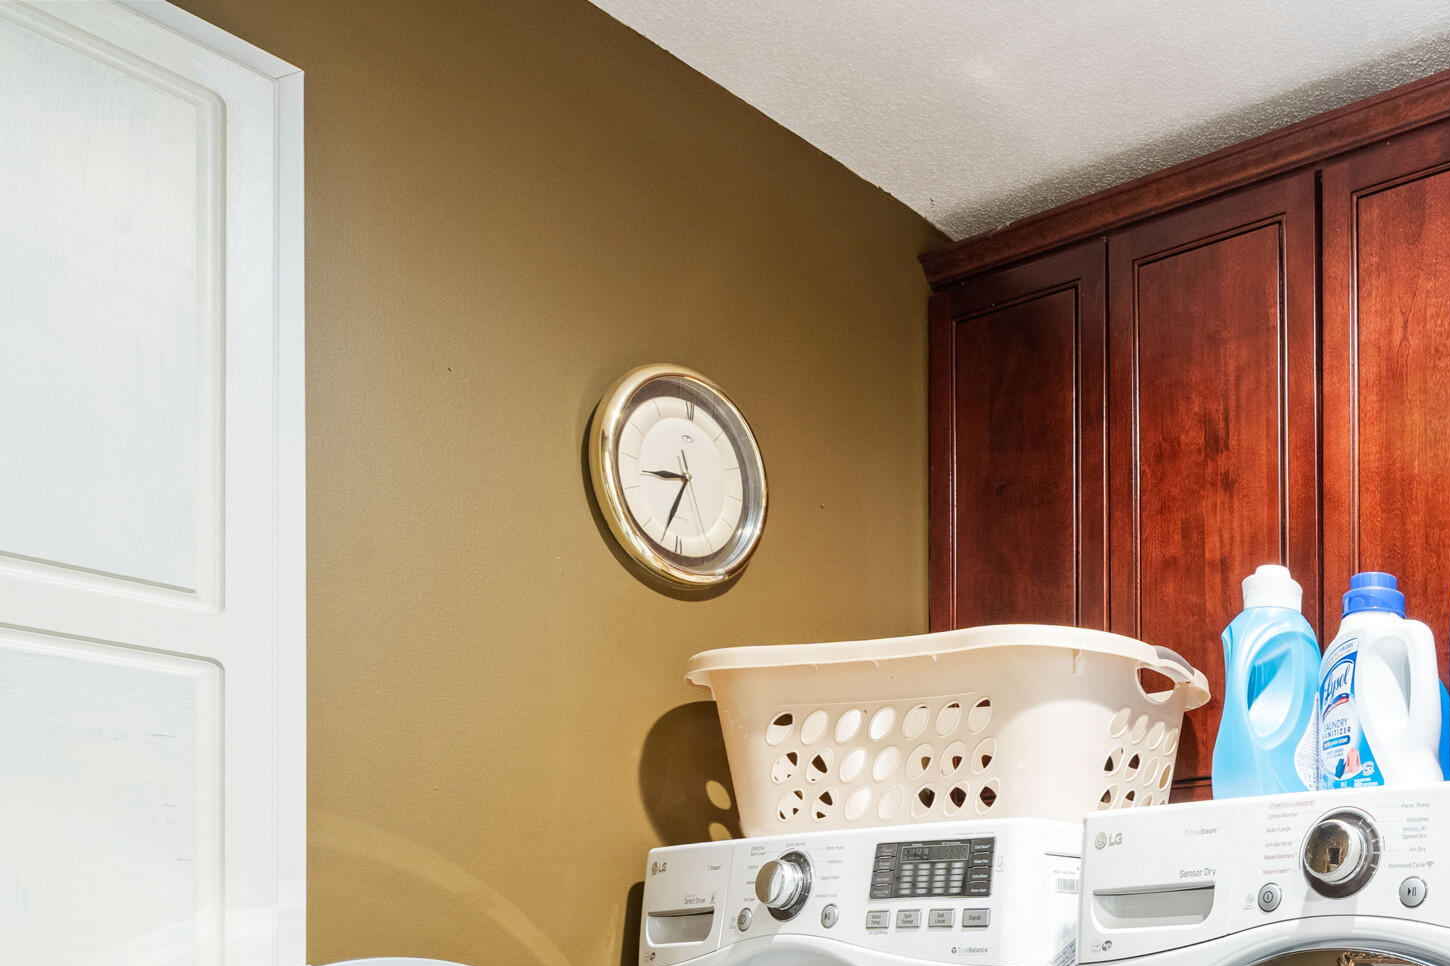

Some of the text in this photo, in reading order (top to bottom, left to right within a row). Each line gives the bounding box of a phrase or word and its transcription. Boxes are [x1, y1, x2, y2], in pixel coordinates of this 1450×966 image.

[1323, 664, 1352, 700] Lysol
[1179, 867, 1217, 879] Sensor Dry
